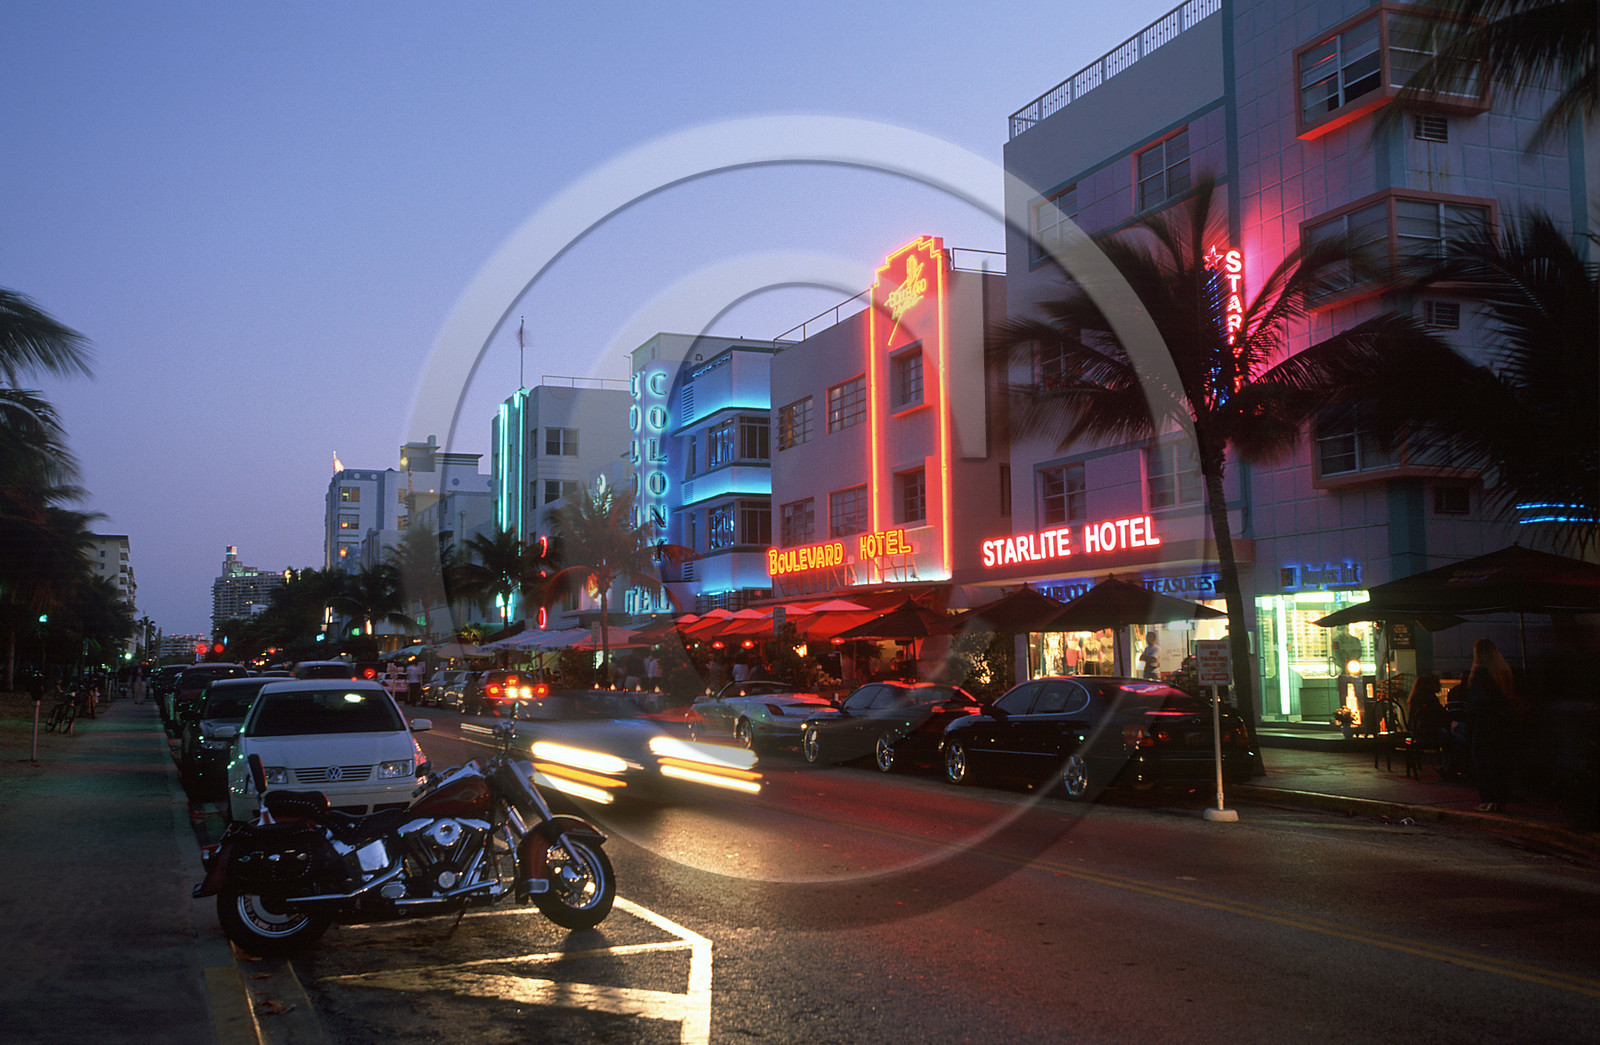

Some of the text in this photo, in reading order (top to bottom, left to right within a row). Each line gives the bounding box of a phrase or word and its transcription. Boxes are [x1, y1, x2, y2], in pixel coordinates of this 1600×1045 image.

[768, 529, 912, 575] BOULEVARD HOTEL
[982, 515, 1161, 568] STARLITE HOTEL
